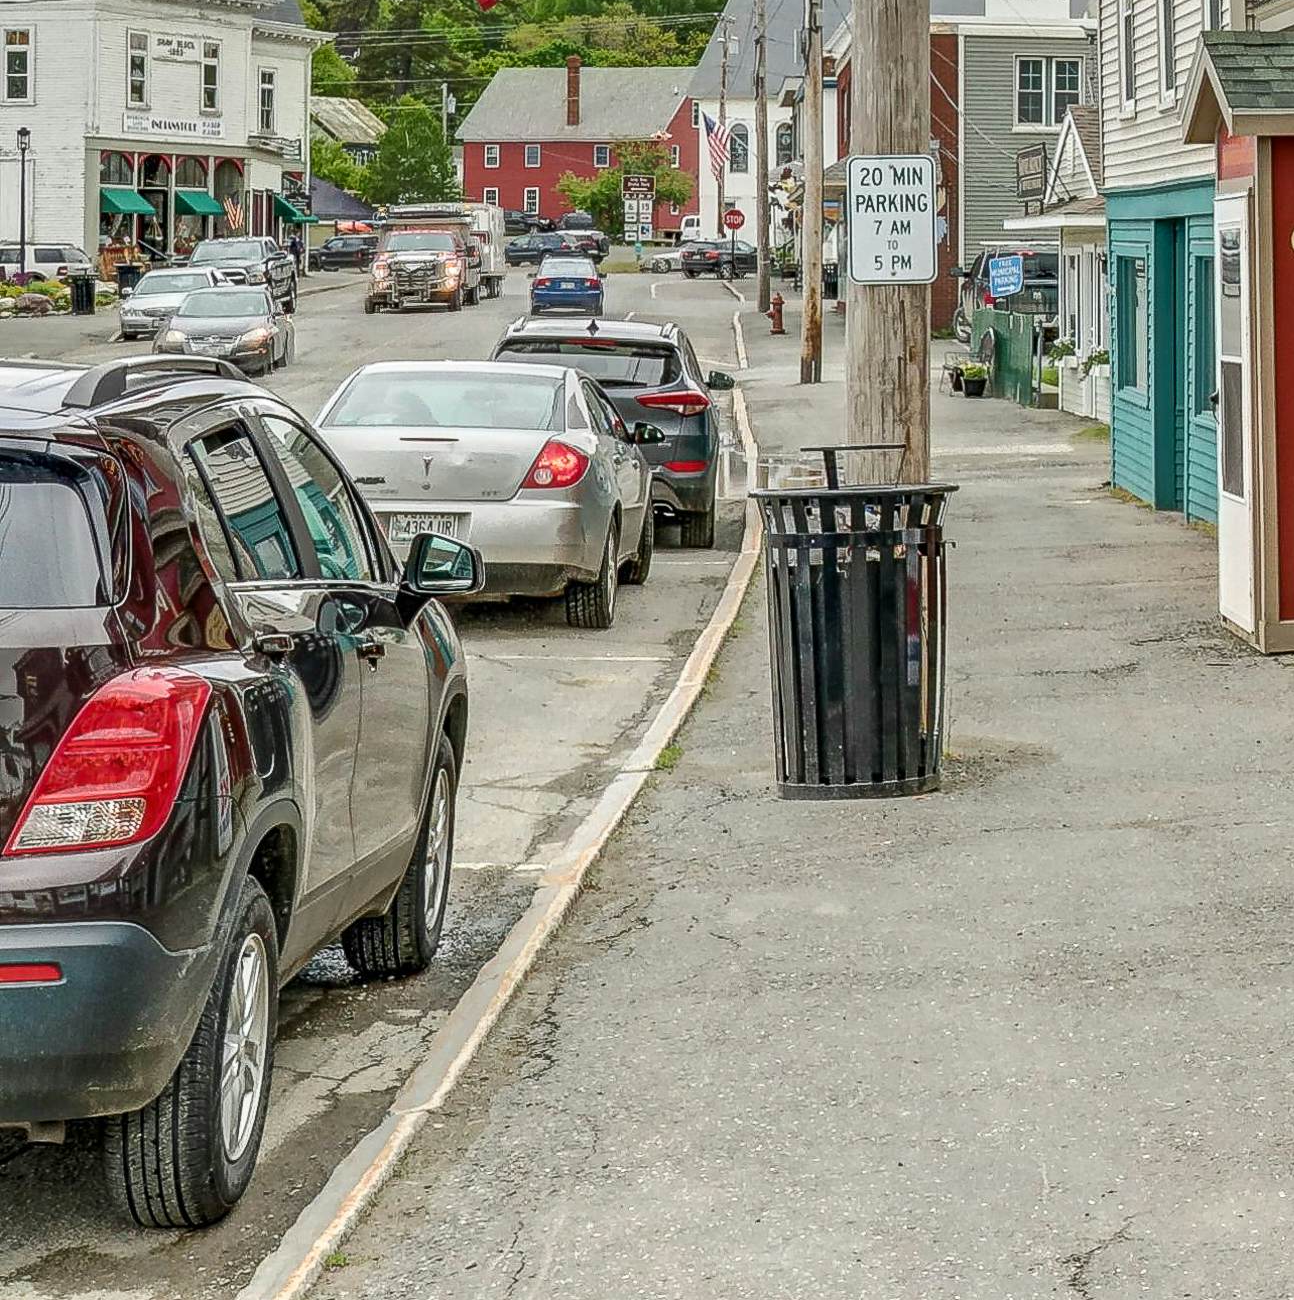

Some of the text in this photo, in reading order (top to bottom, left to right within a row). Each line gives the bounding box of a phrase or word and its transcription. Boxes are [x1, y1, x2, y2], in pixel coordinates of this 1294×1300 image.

[860, 166, 923, 186] 20 MIN
[855, 193, 928, 213] PARKING
[726, 214, 742, 224] STOP
[873, 220, 911, 235] 7 AM
[887, 240, 899, 250] TO
[874, 255, 912, 271] 5 PM
